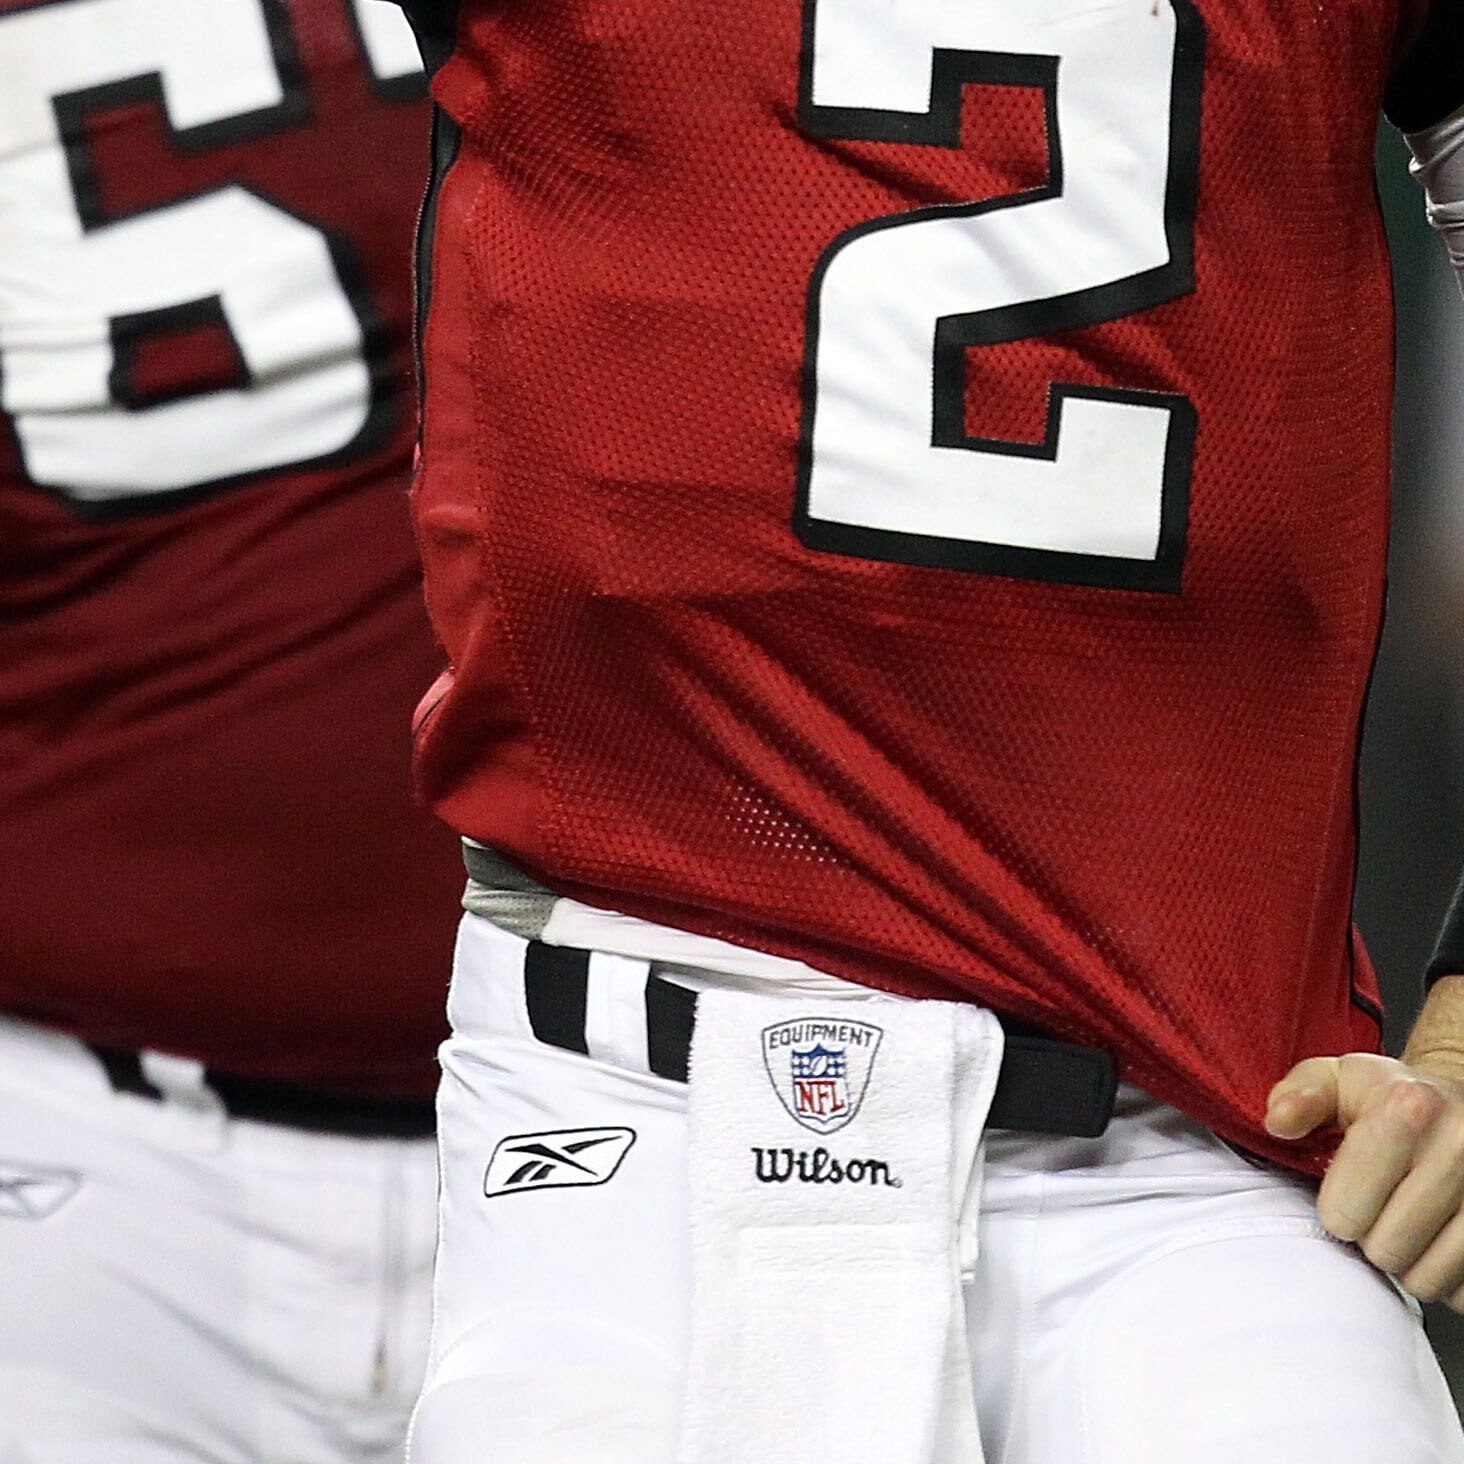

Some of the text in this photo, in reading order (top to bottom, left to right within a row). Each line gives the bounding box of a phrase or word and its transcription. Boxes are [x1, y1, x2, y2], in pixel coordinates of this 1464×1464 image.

[768, 1023, 875, 1050] EQUIPMENT
[793, 1080, 847, 1116] NFL
[750, 1146, 902, 1188] Wilson
